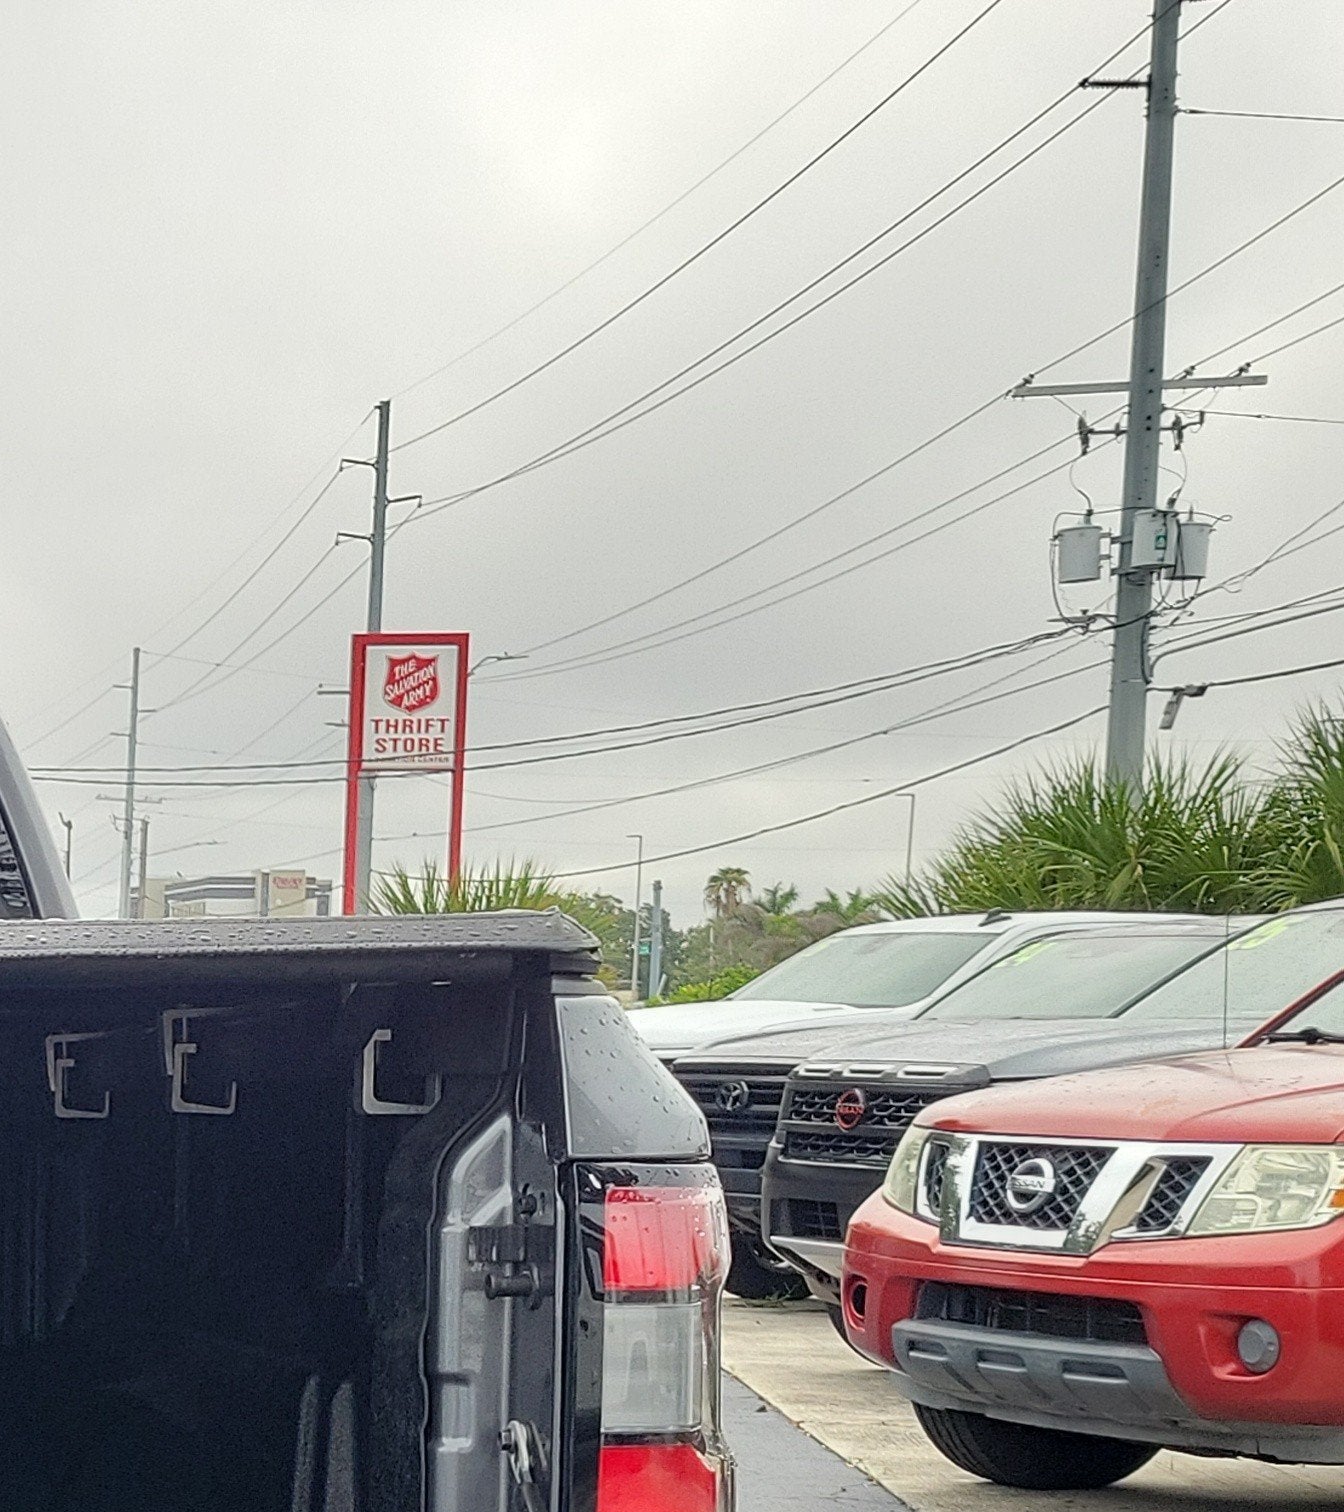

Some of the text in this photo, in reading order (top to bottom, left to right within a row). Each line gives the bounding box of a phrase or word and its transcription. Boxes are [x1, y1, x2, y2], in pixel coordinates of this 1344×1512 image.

[393, 659, 417, 680] THE
[384, 661, 435, 700] SALVATION
[401, 680, 433, 709] ARMY
[370, 718, 450, 734] THRIFT
[374, 737, 445, 753] STORE
